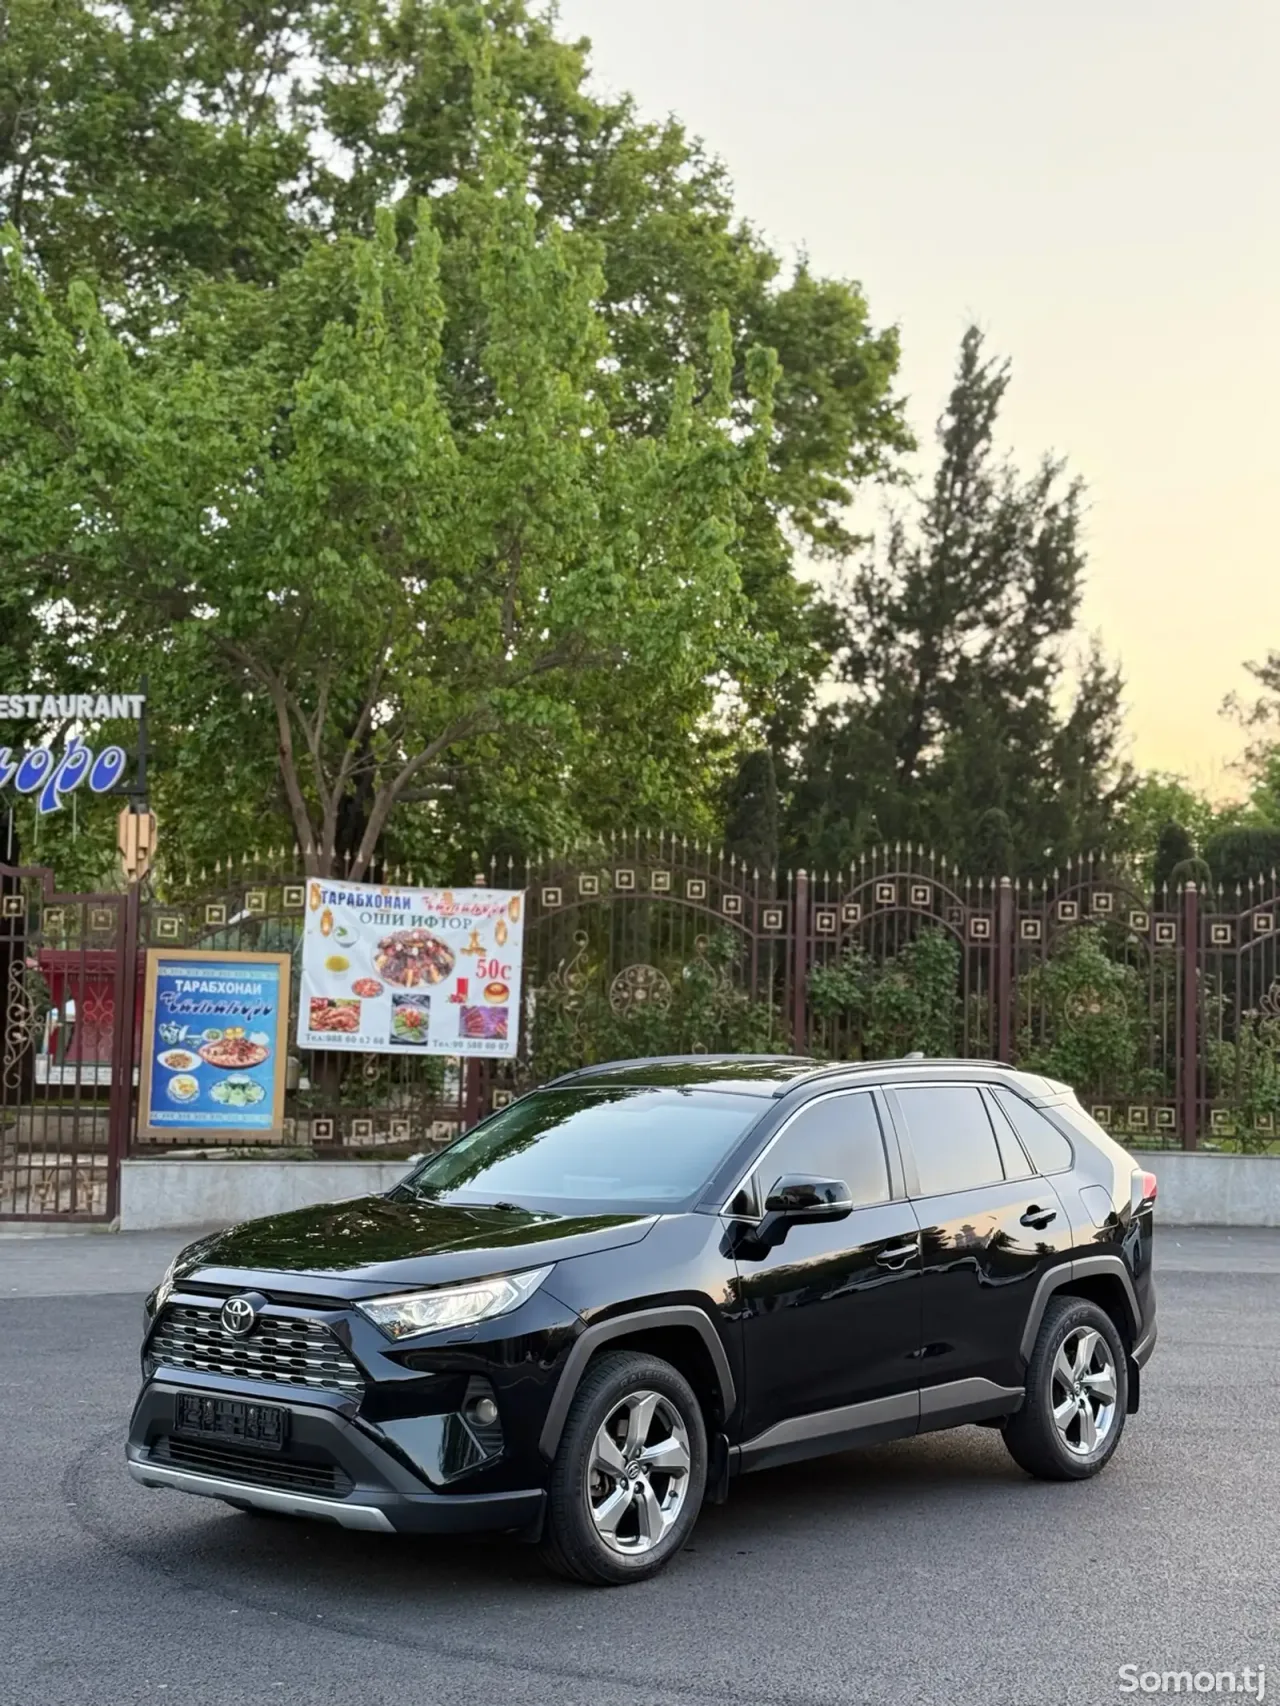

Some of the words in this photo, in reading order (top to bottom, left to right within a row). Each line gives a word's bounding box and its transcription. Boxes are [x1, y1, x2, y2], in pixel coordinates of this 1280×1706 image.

[0, 695, 146, 719] ESTAURANT
[360, 911, 404, 926] ОШИ
[411, 915, 472, 930] ИФТОР
